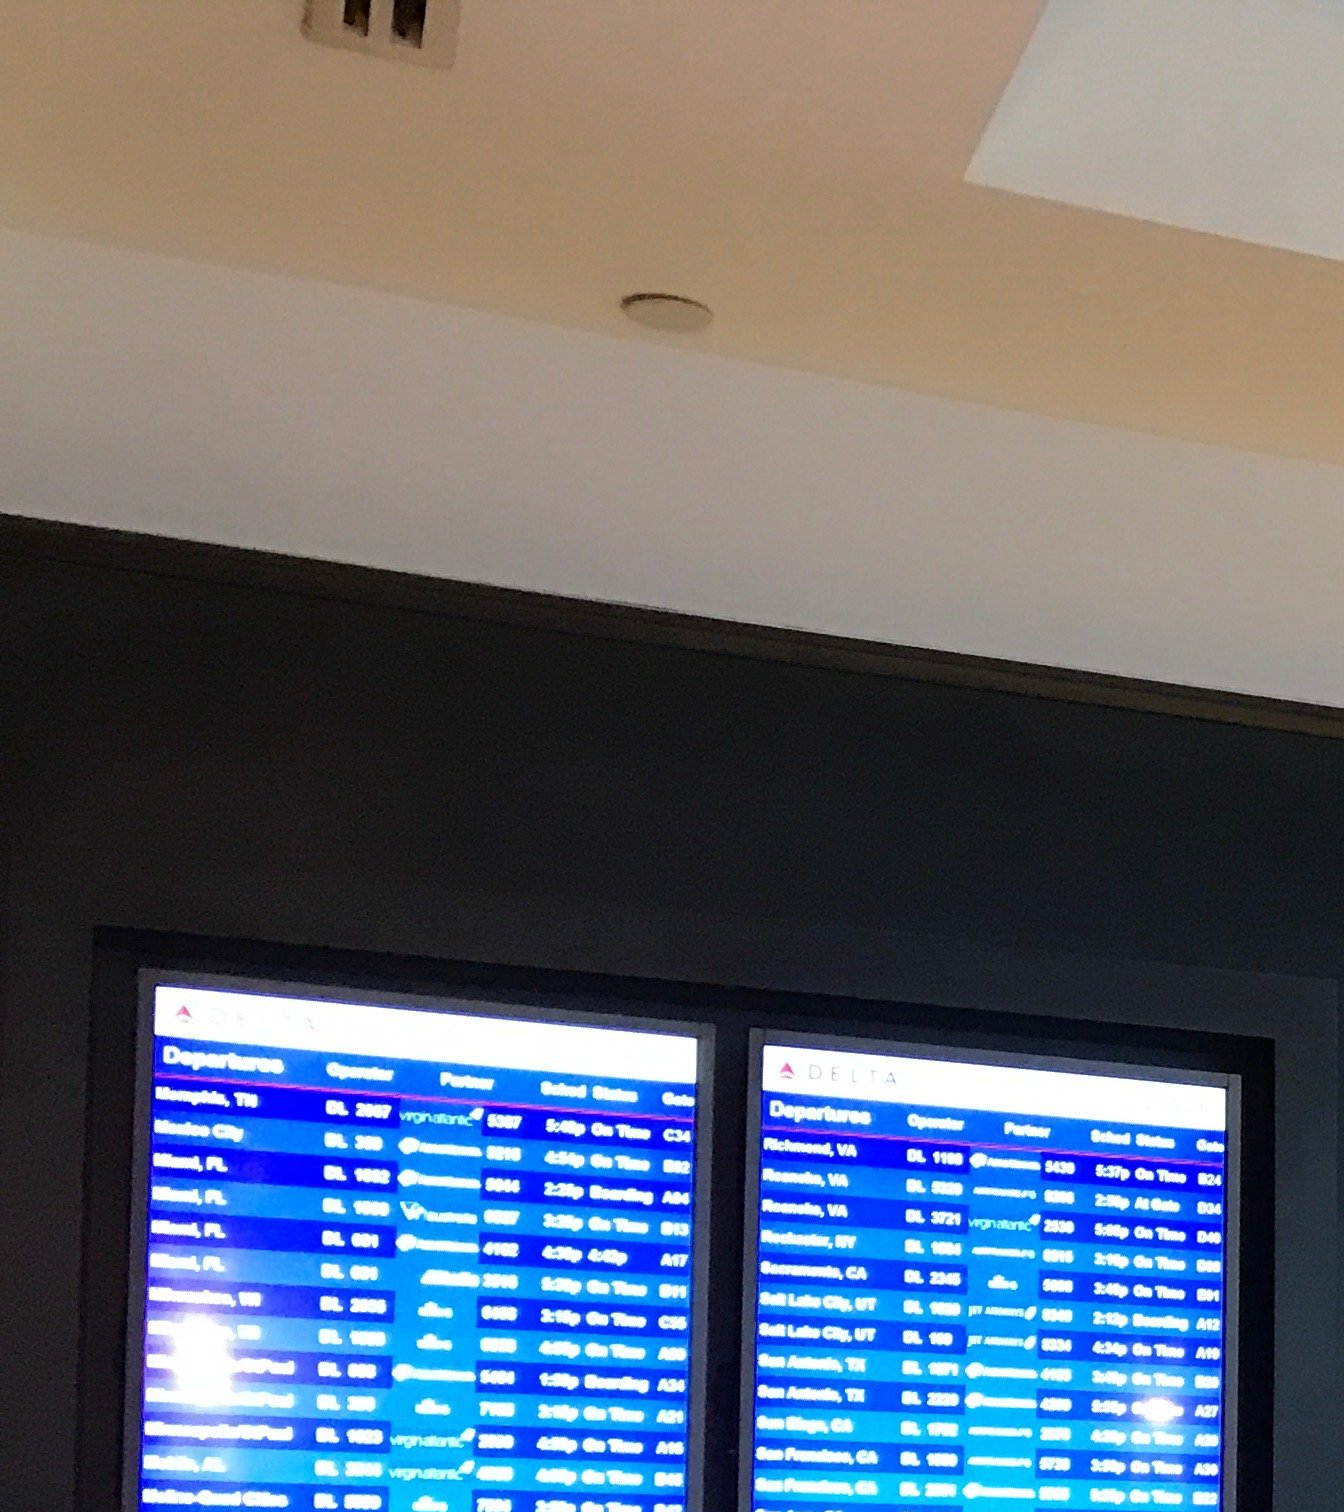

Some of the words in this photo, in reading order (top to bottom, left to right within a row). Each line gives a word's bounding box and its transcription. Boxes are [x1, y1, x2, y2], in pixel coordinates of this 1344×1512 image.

[163, 1045, 285, 1075] Departures
[809, 1064, 897, 1084] DELTA
[770, 1101, 871, 1124] Departures
[837, 1144, 856, 1156] VA
[846, 1267, 866, 1279] CA
